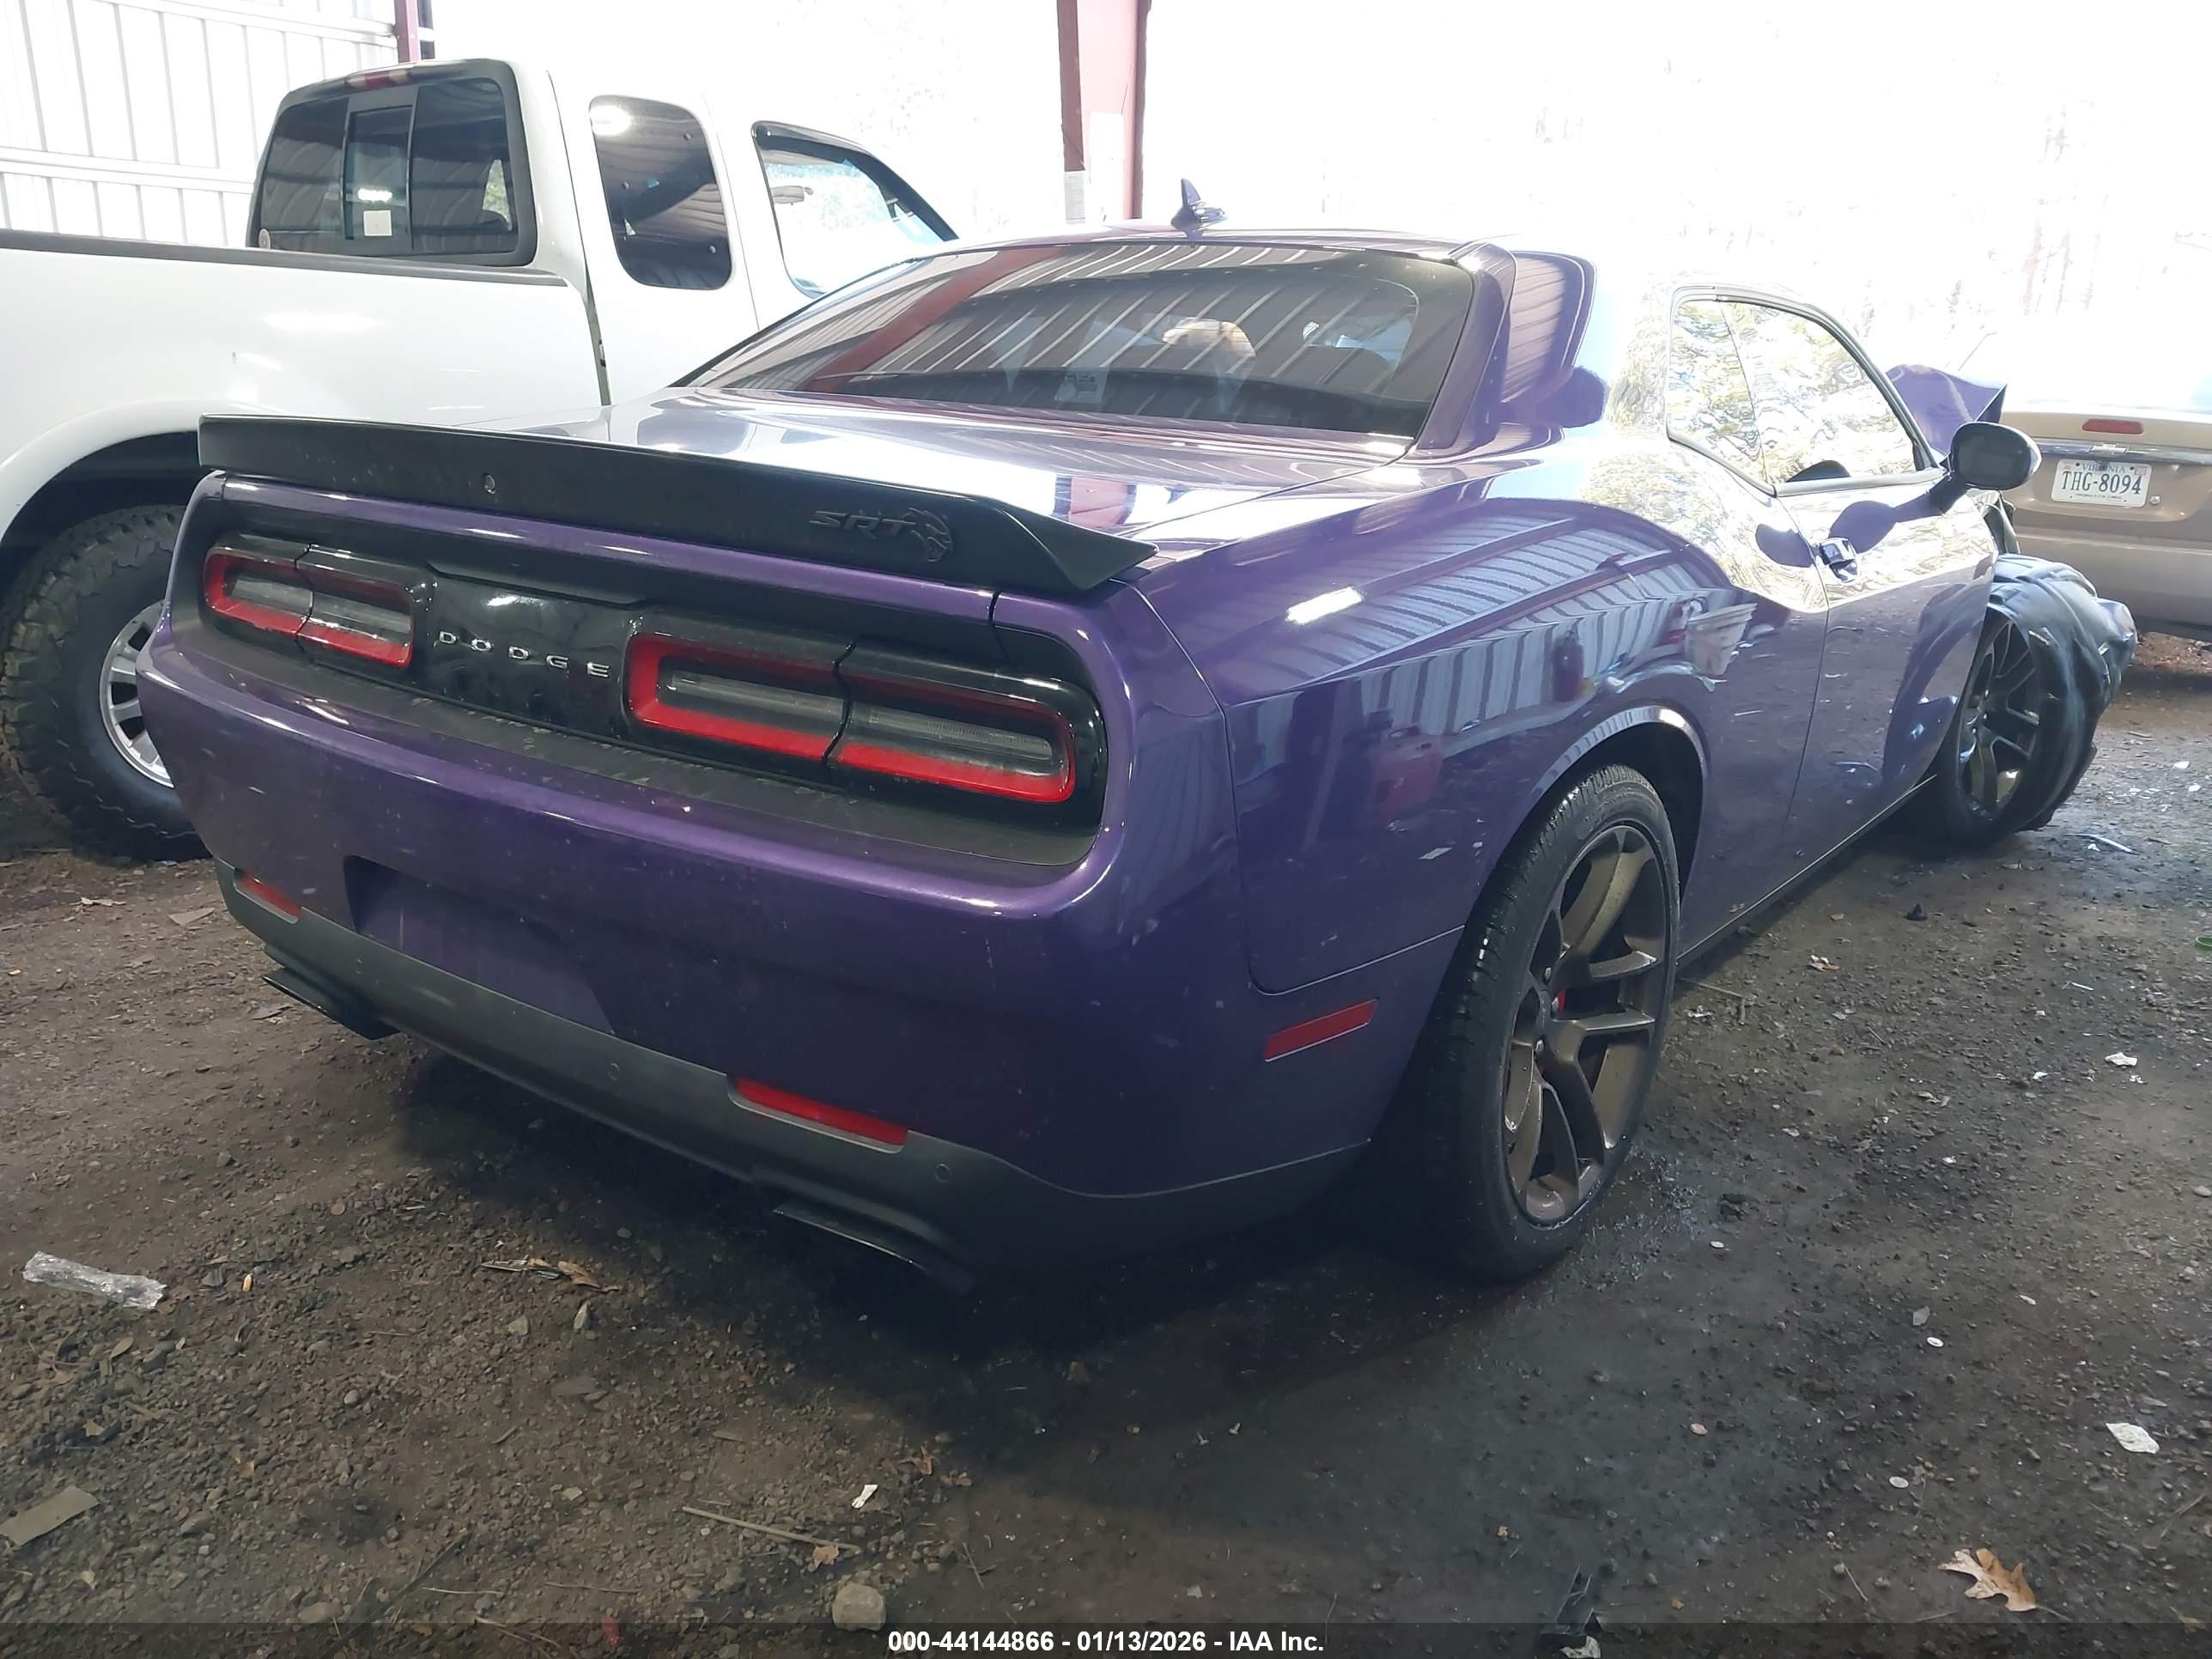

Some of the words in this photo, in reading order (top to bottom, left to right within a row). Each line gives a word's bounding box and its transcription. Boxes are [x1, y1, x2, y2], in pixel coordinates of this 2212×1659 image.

[2062, 471, 2142, 495] THG-8094
[809, 510, 916, 539] SRT
[439, 630, 611, 678] DODGE
